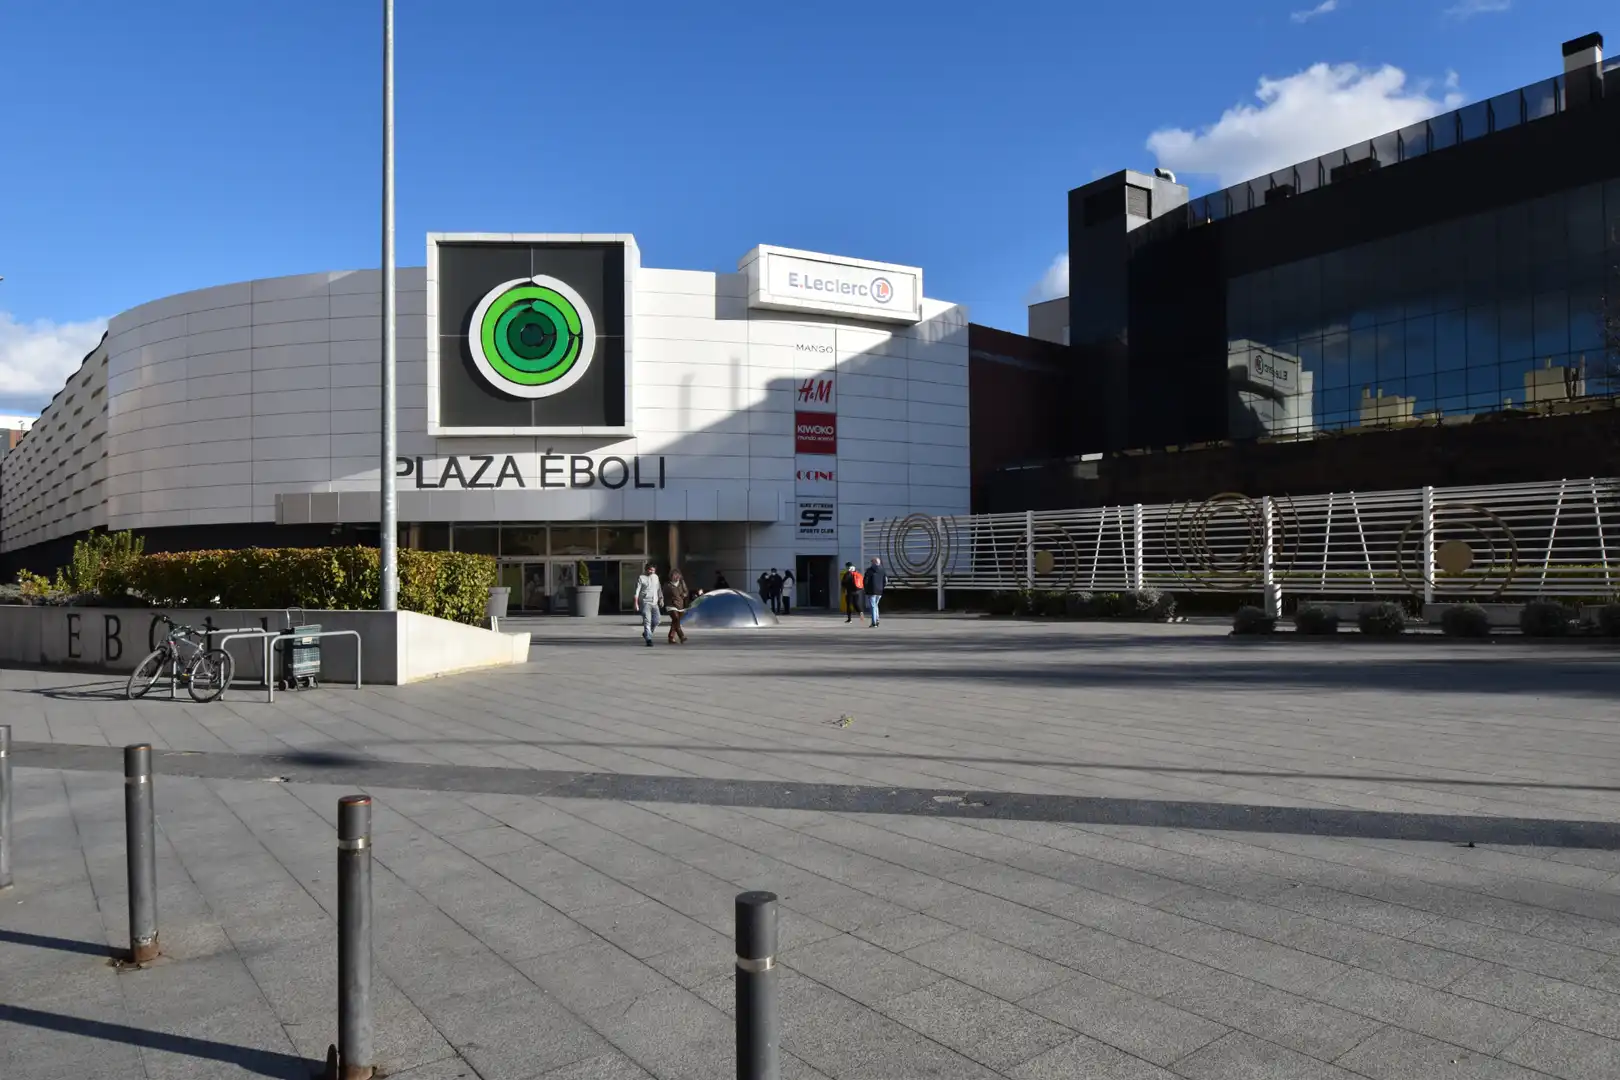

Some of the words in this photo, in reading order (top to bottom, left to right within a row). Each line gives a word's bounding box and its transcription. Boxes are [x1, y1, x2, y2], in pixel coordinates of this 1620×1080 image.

[788, 272, 868, 297] E.Leclerc
[796, 344, 834, 354] MANGO
[798, 378, 833, 404] H&M
[797, 424, 834, 435] KIWOKO
[540, 447, 665, 490] ÉBOLI
